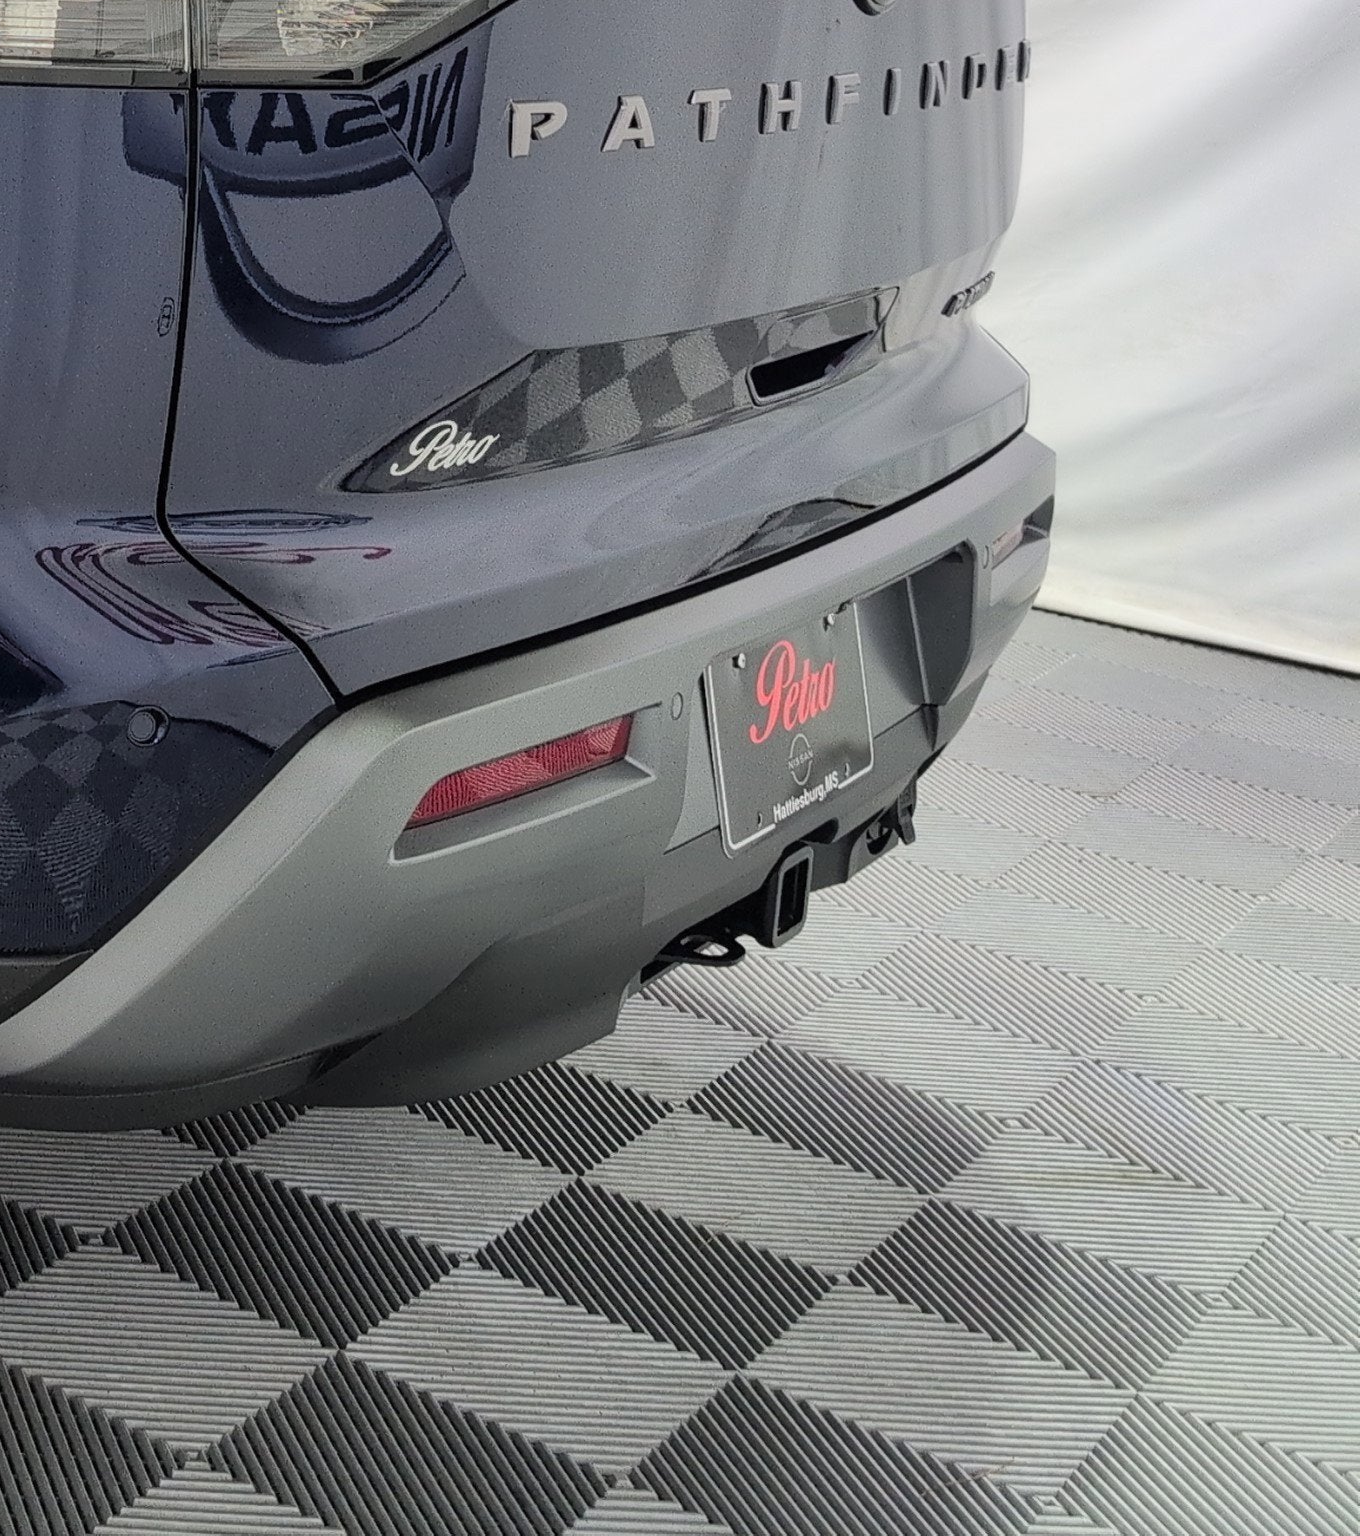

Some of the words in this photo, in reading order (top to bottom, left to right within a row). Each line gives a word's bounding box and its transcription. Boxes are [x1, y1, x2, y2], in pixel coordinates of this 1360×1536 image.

[389, 419, 501, 477] Petro
[748, 639, 837, 744] Petro
[787, 748, 814, 770] NISSAN
